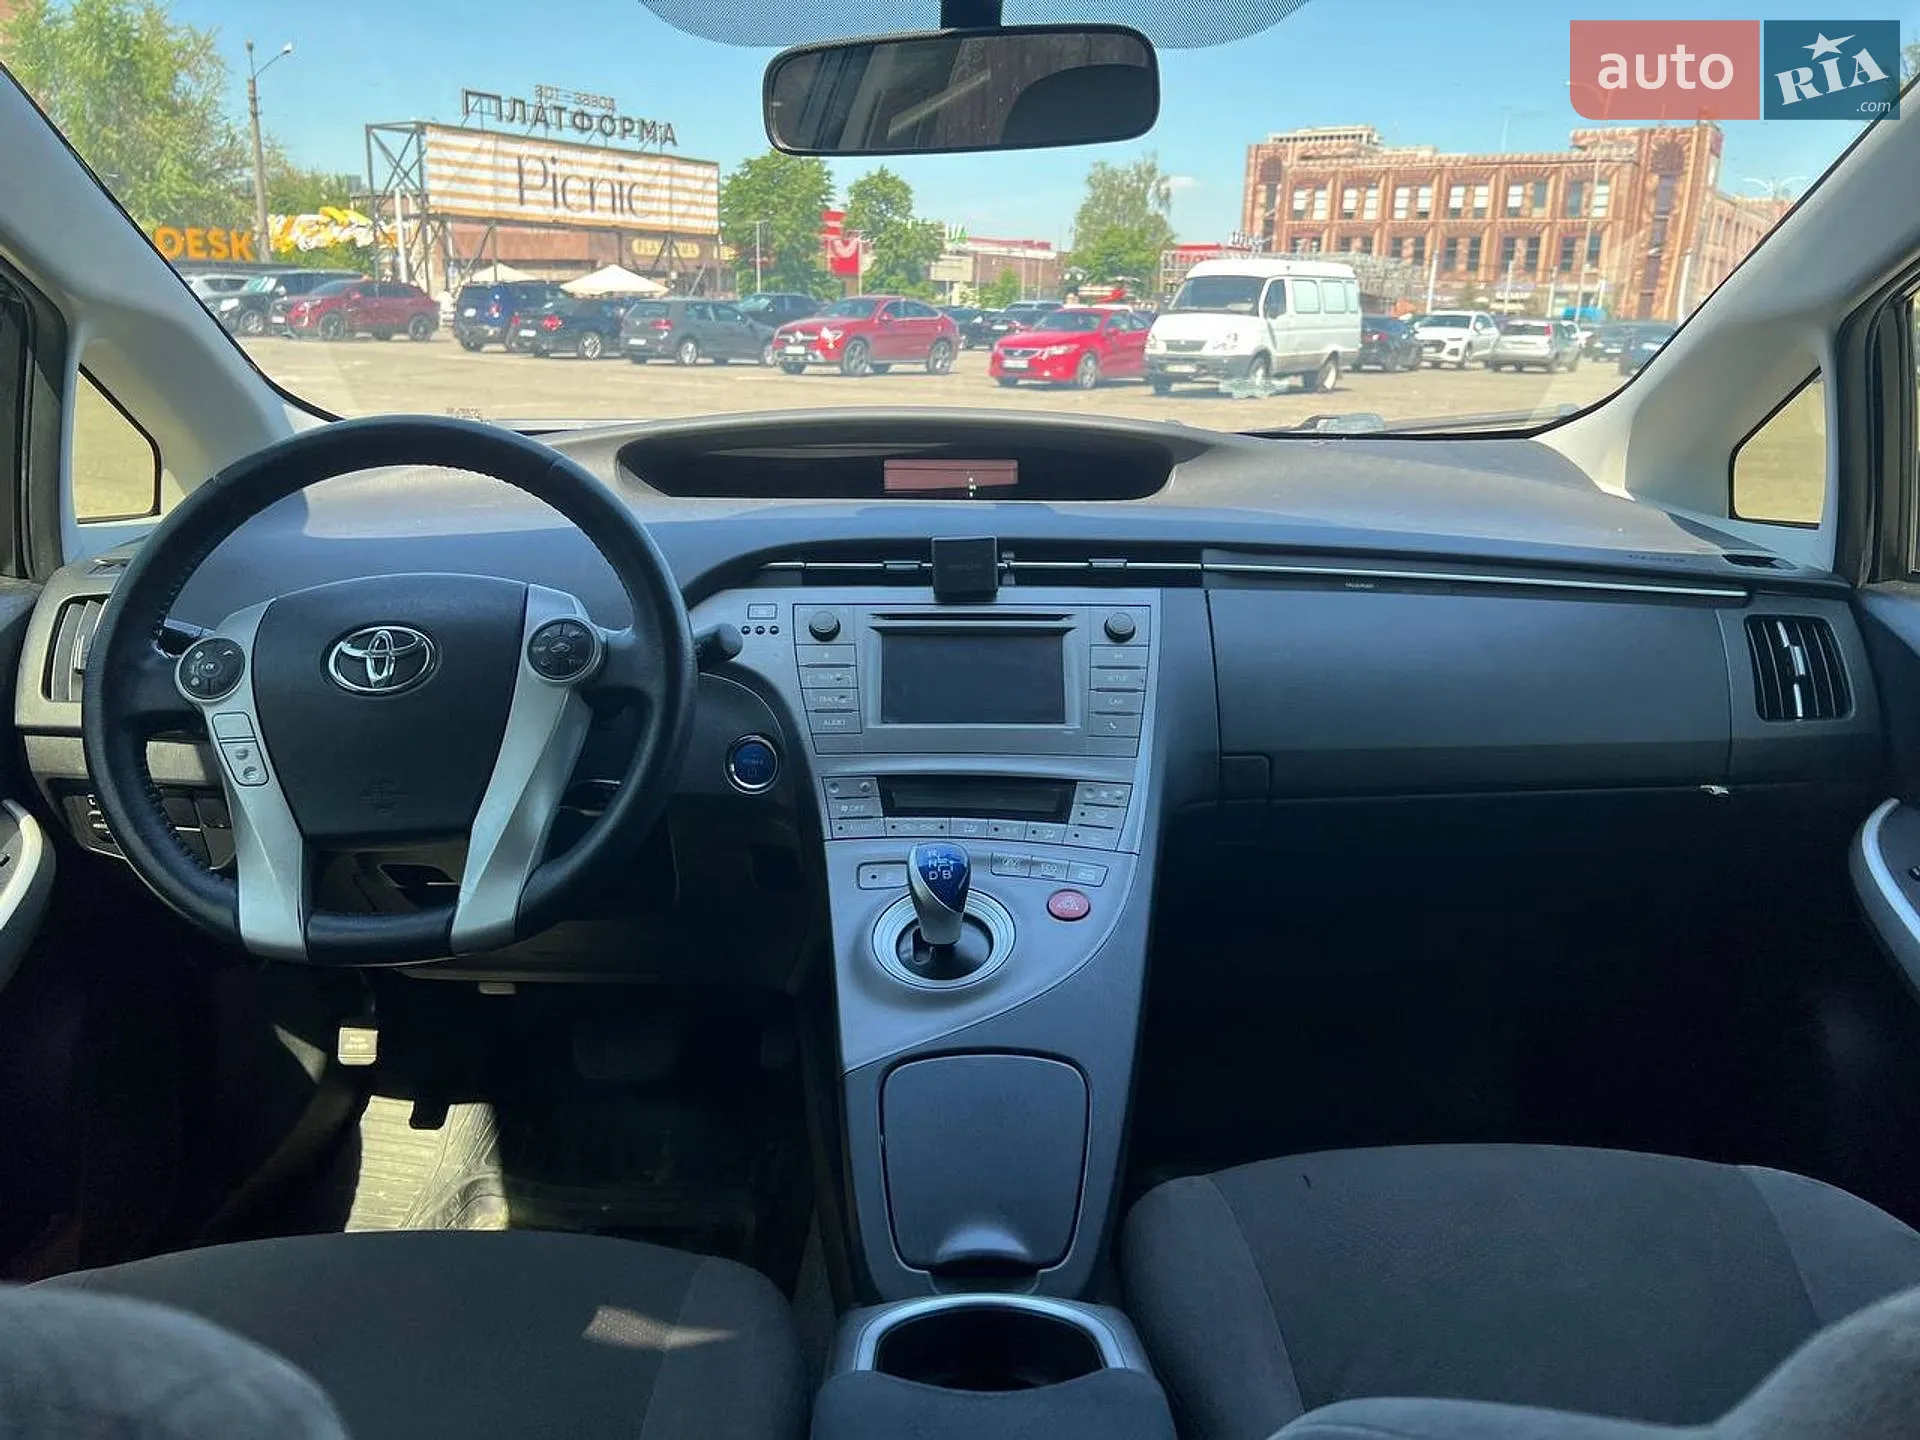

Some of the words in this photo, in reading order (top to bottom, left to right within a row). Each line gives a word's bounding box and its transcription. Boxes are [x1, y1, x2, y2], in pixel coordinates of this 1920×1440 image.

[462, 88, 679, 147] ПЛАТФОРМА
[516, 155, 650, 219] Picnic
[154, 225, 254, 264] DESK
